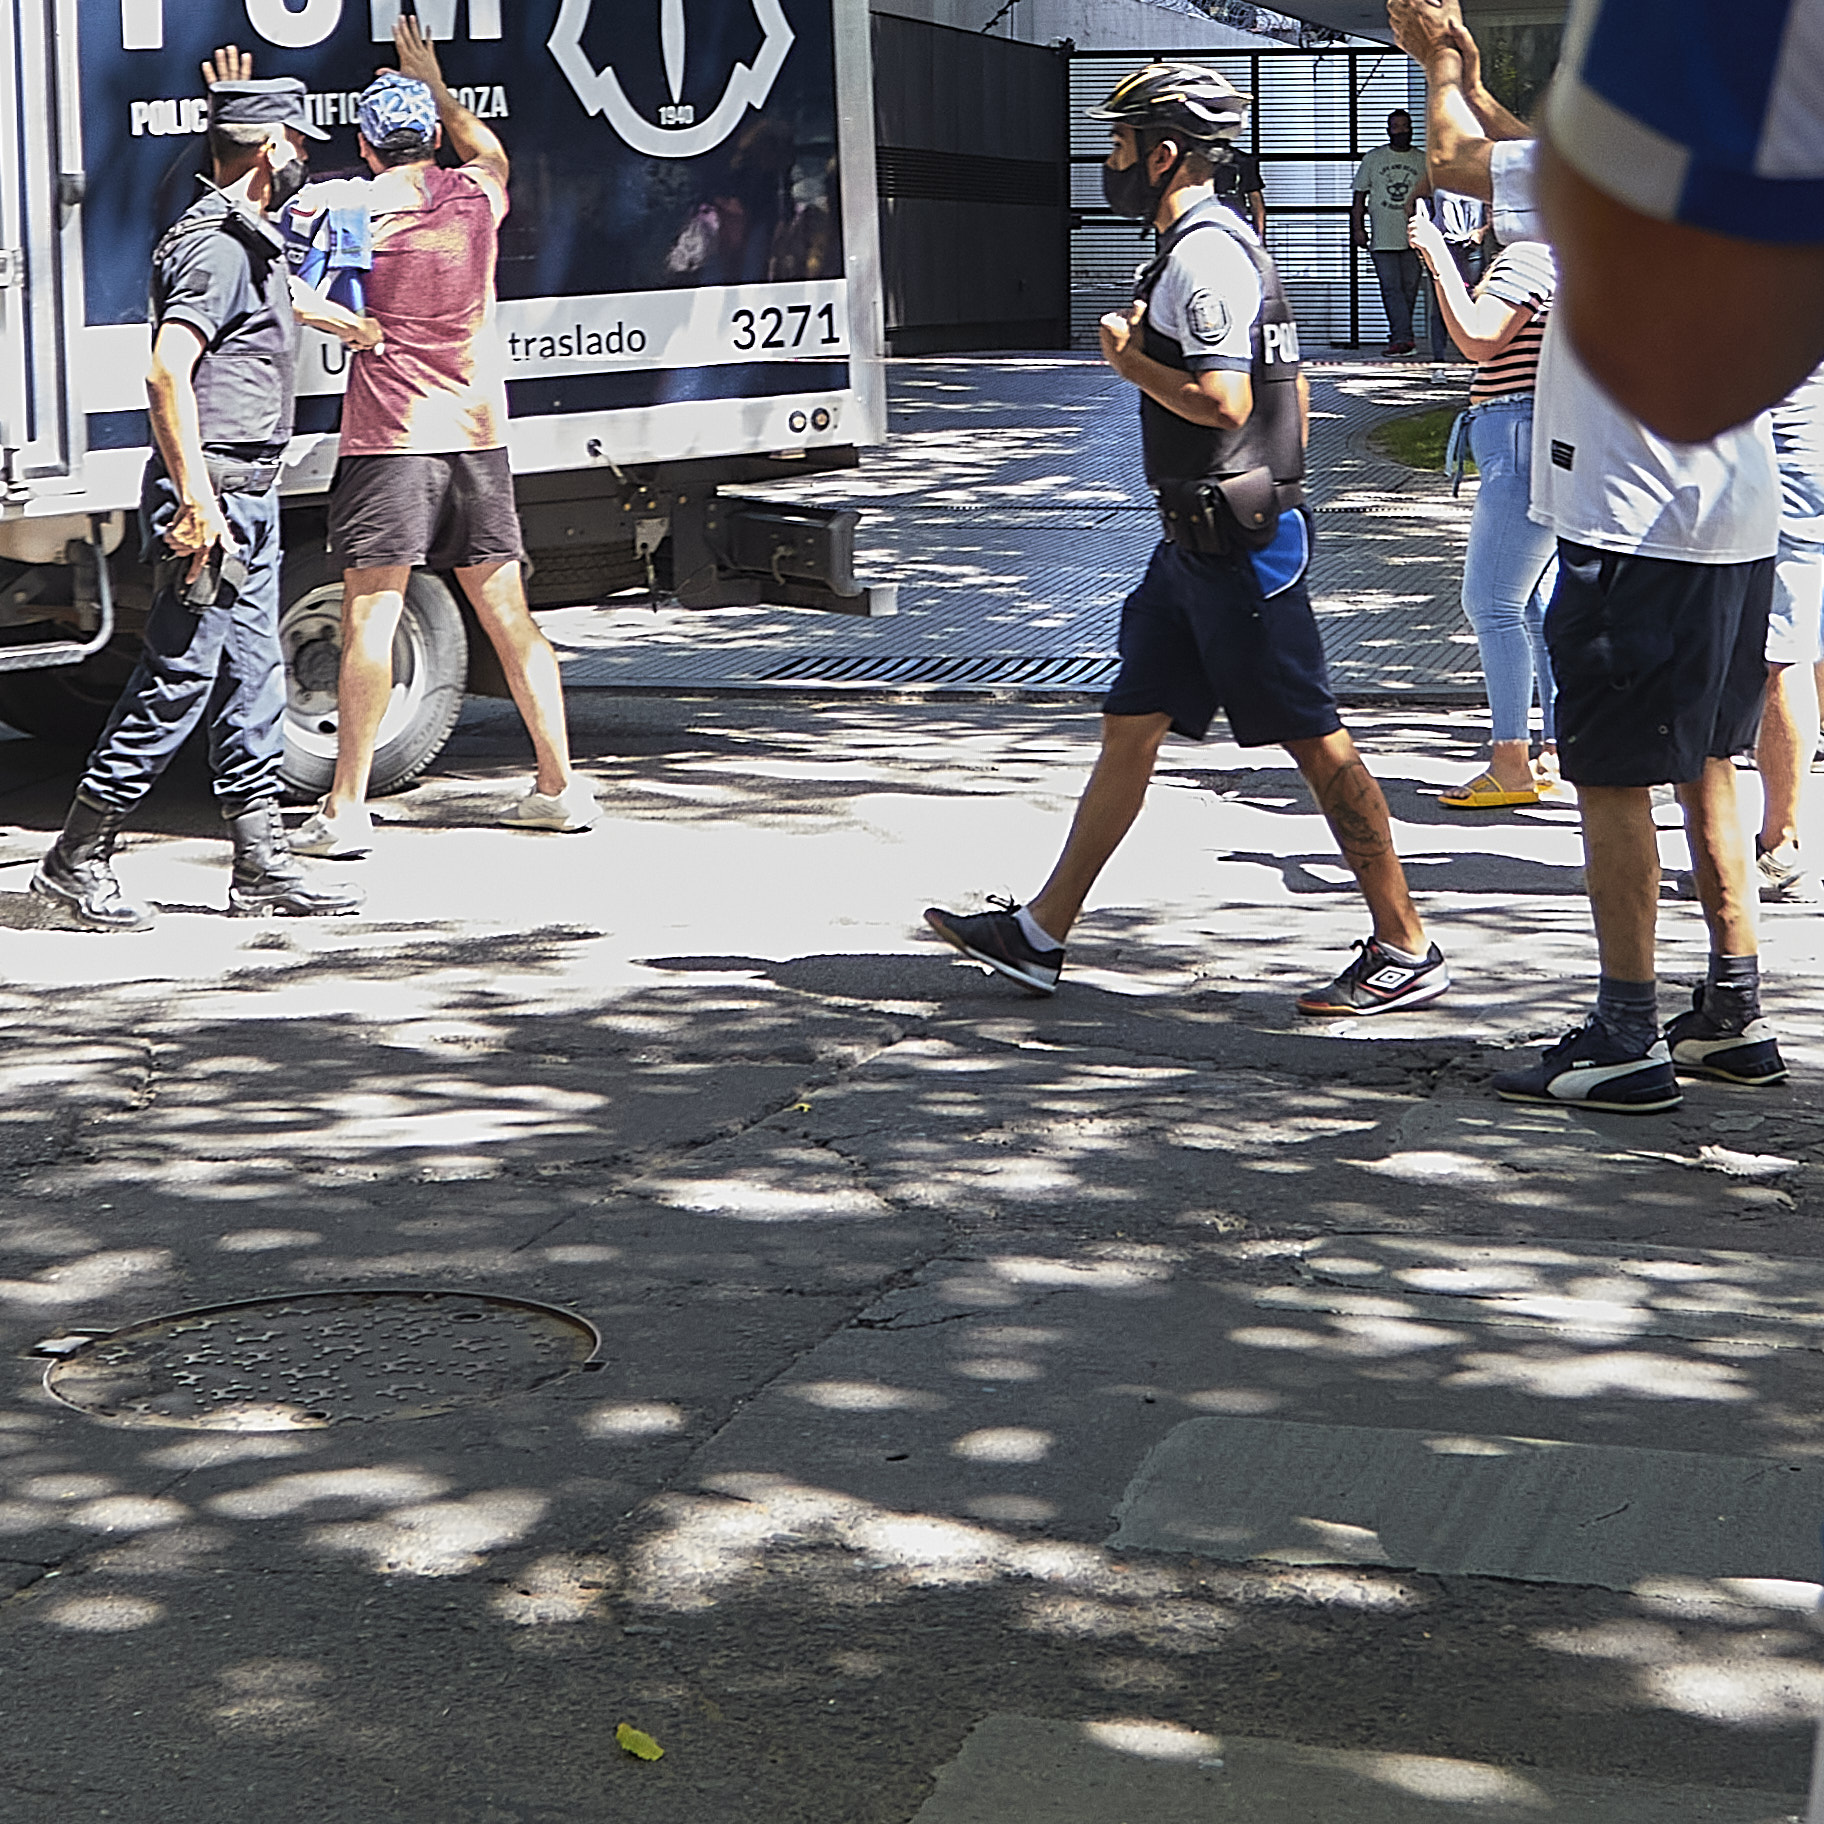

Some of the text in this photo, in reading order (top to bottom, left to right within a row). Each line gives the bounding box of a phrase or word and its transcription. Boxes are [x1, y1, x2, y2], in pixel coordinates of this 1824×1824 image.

[130, 98, 208, 136] POLIC
[508, 321, 647, 361] traslado
[731, 303, 840, 350] 3271
